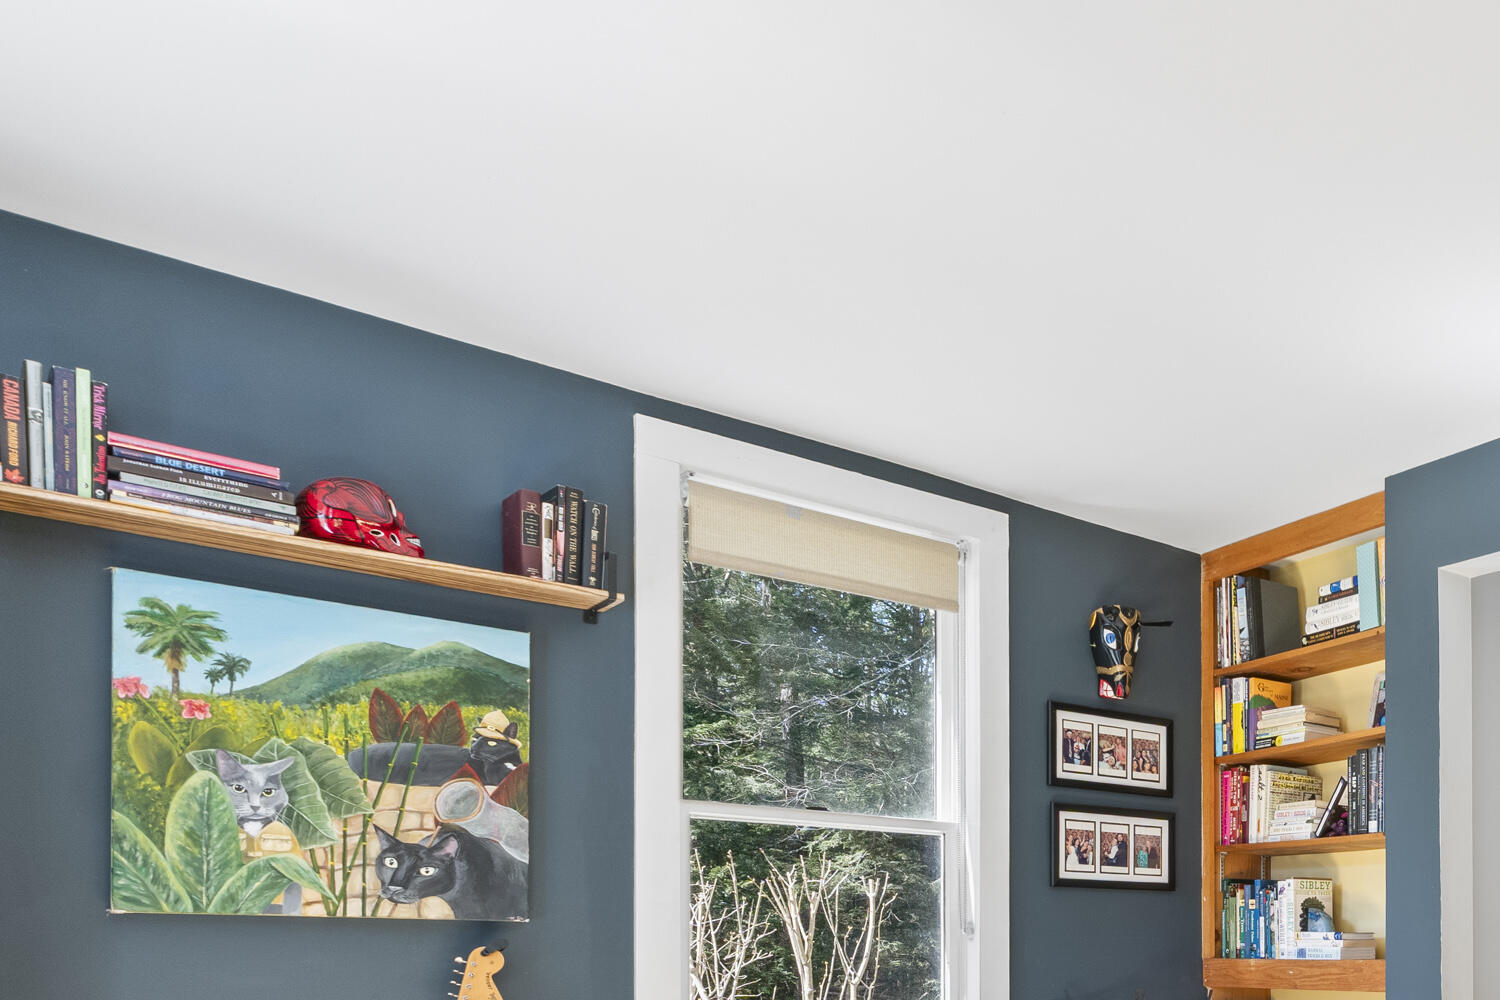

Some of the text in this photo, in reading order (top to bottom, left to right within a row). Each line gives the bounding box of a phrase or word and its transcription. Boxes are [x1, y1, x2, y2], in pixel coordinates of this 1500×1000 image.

[2, 378, 21, 420] CANADA
[92, 385, 107, 430] Trick Mirror
[7, 421, 19, 466] RICHARD FORD
[154, 455, 226, 477] BLUE DESERT
[185, 496, 227, 509] MOUNTAIN
[568, 500, 579, 573] WATCH ON THE WALL
[1299, 881, 1331, 890] SIBLEY
